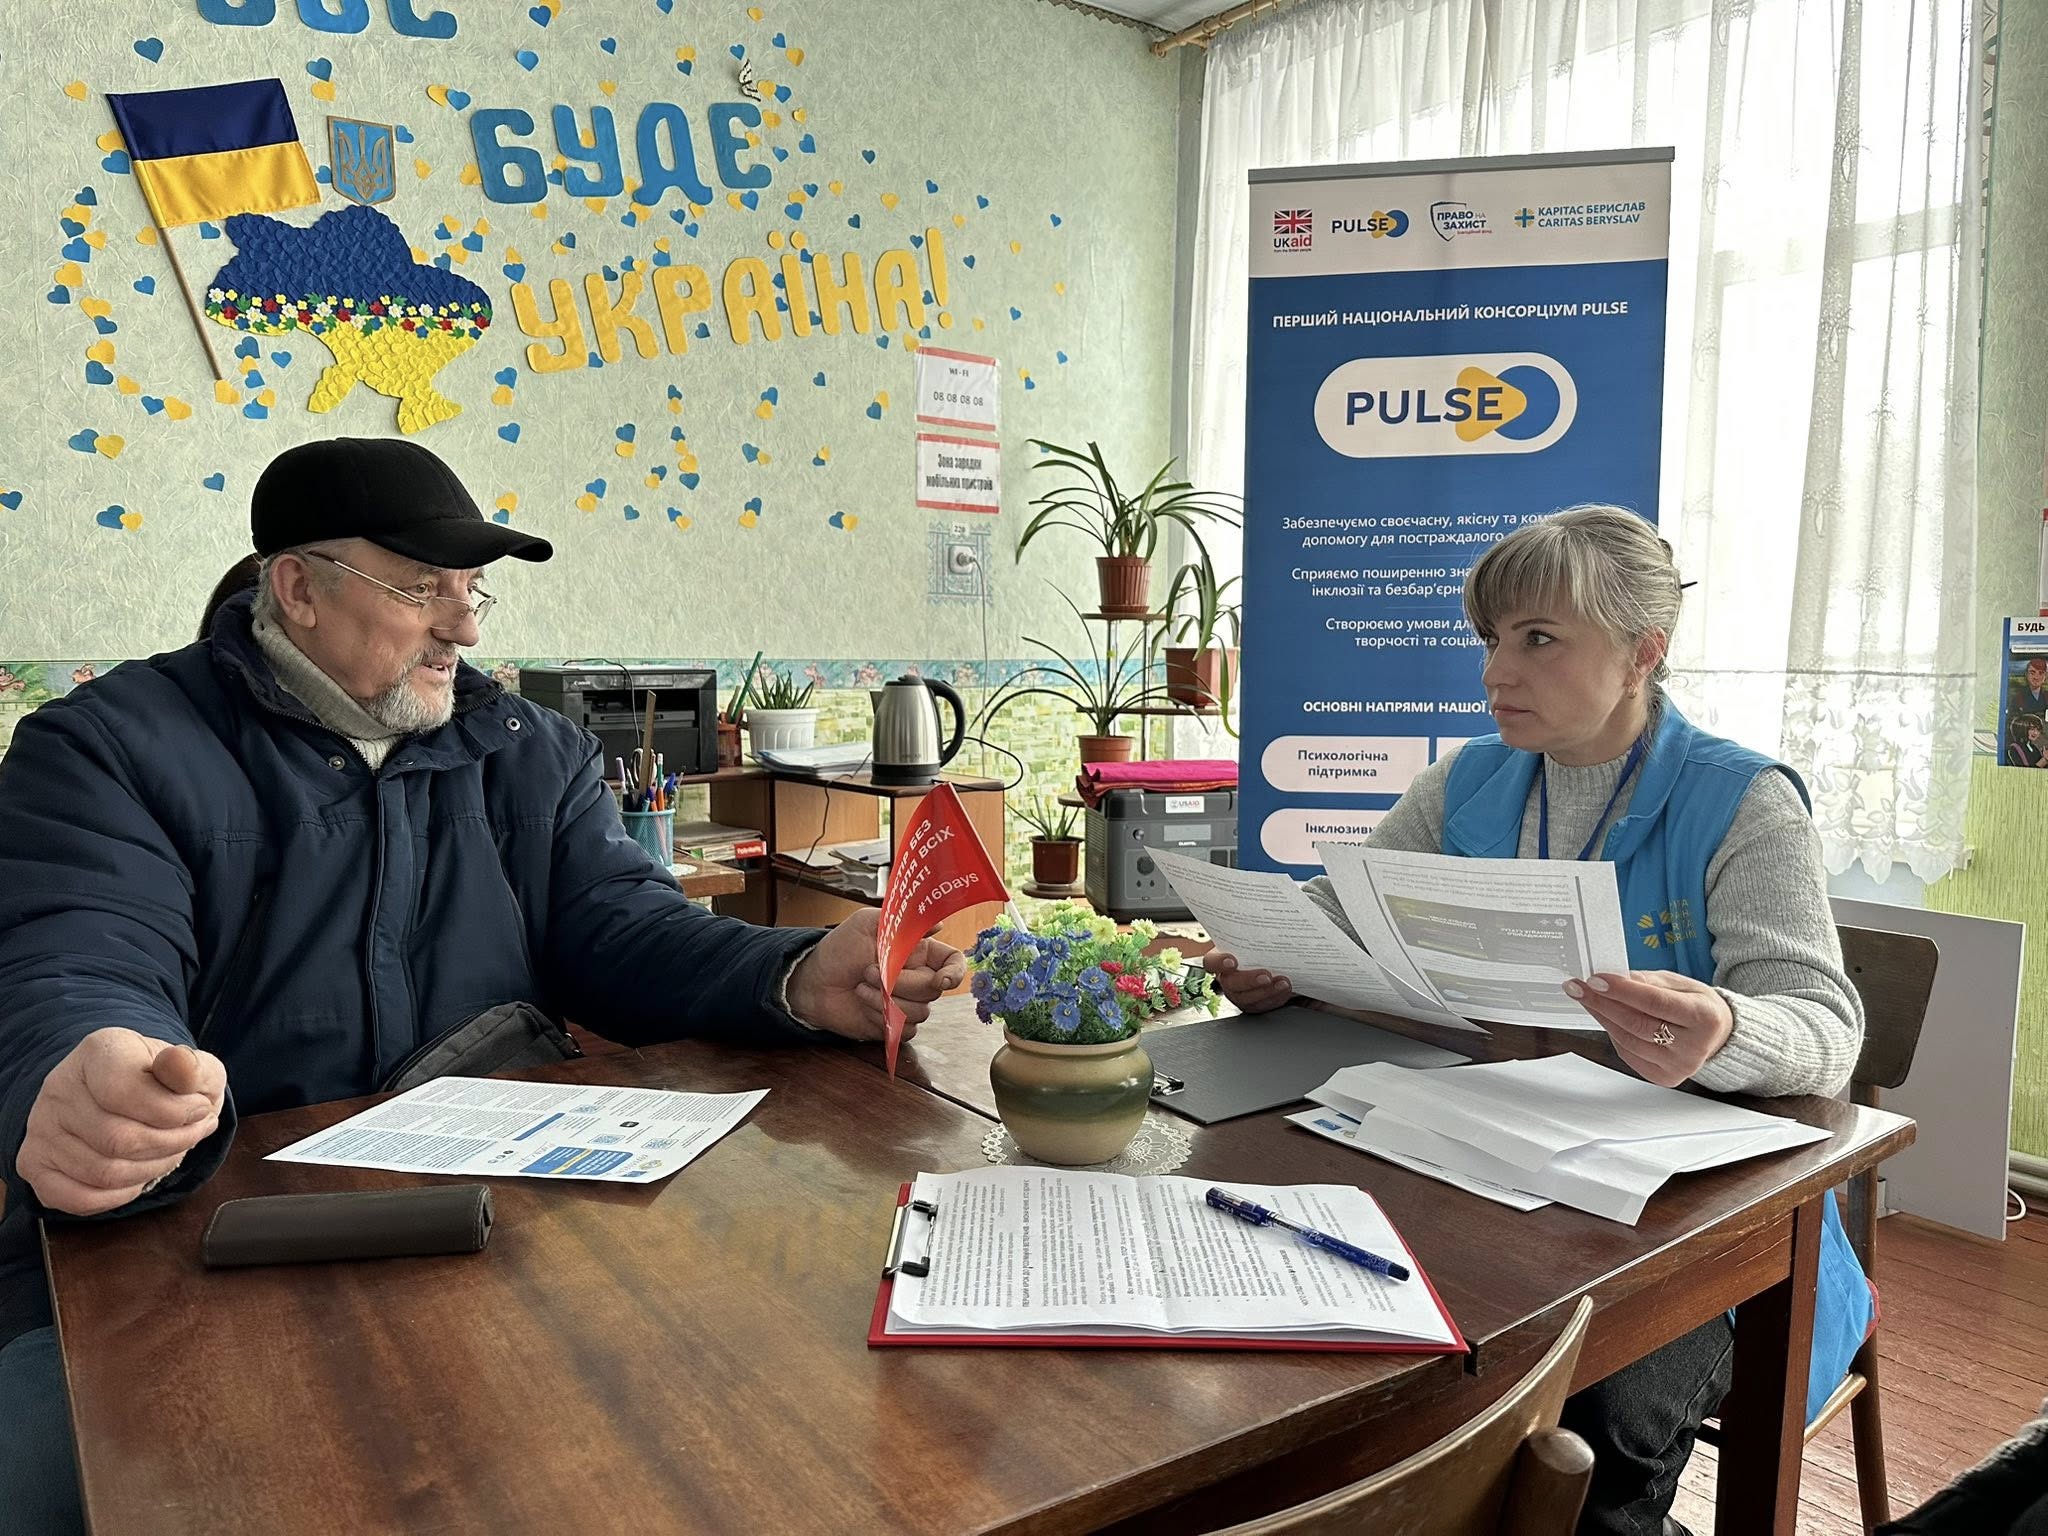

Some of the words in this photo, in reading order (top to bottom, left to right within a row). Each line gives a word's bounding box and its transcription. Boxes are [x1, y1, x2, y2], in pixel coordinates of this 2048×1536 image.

[470, 102, 772, 205] БУДЕ
[1437, 211, 1474, 221] ПРАВО
[1538, 205, 1584, 216] КАРІТАС
[1586, 202, 1645, 214] БЕРИСЛАВ
[1331, 218, 1389, 234] PULSE
[1443, 220, 1487, 230] ЗАХИСТ
[1538, 215, 1583, 228] CARITAS
[1586, 214, 1640, 226] BERYSLAV
[1273, 234, 1312, 248] UKaid
[511, 227, 952, 373] УКРАЇНА!
[1272, 310, 1338, 328] ПЕРШИЙ
[1342, 304, 1470, 326] НАЦІОНАЛЬНИЙ
[1474, 303, 1577, 320] КОНСОРЦІУМ
[1582, 301, 1628, 315] PULSE
[933, 391, 944, 401] 08
[946, 393, 957, 403] 08
[960, 394, 971, 405] 08
[973, 396, 984, 406] 08
[1345, 386, 1504, 426] PULSE
[1282, 517, 1377, 531] Забезпечуємо
[1380, 516, 1453, 528] своєчасну,
[1456, 512, 1499, 528] якісну
[1503, 514, 1517, 524] та
[1521, 514, 1552, 524] ком
[1302, 535, 1368, 548] допомогу
[1371, 534, 1394, 547] для
[1399, 532, 1504, 546] постраждалого
[1291, 567, 1358, 582] Сприяємо
[1362, 567, 1446, 581] поширенню
[1312, 584, 1364, 596] інклюзії
[1368, 586, 1381, 596] та
[1325, 618, 1403, 632] Створюємо
[1406, 619, 1450, 632] умови
[2017, 623, 2045, 632] БУДЬ
[1355, 634, 1419, 649] творчості
[1423, 637, 1437, 646] та
[1303, 701, 1362, 713] ОСНОВНІ
[1365, 701, 1433, 713] НАПРЯМИ
[1438, 700, 1487, 713] НАШОЇ
[1298, 750, 1389, 761] Психологічна
[1308, 765, 1377, 779] підтримка
[909, 819, 932, 850] БЕЗ
[899, 858, 918, 898] ДЛЯ
[918, 825, 955, 859] ВСІХ
[894, 865, 931, 930] ДІВЧАТ!
[917, 872, 979, 915] #16Days
